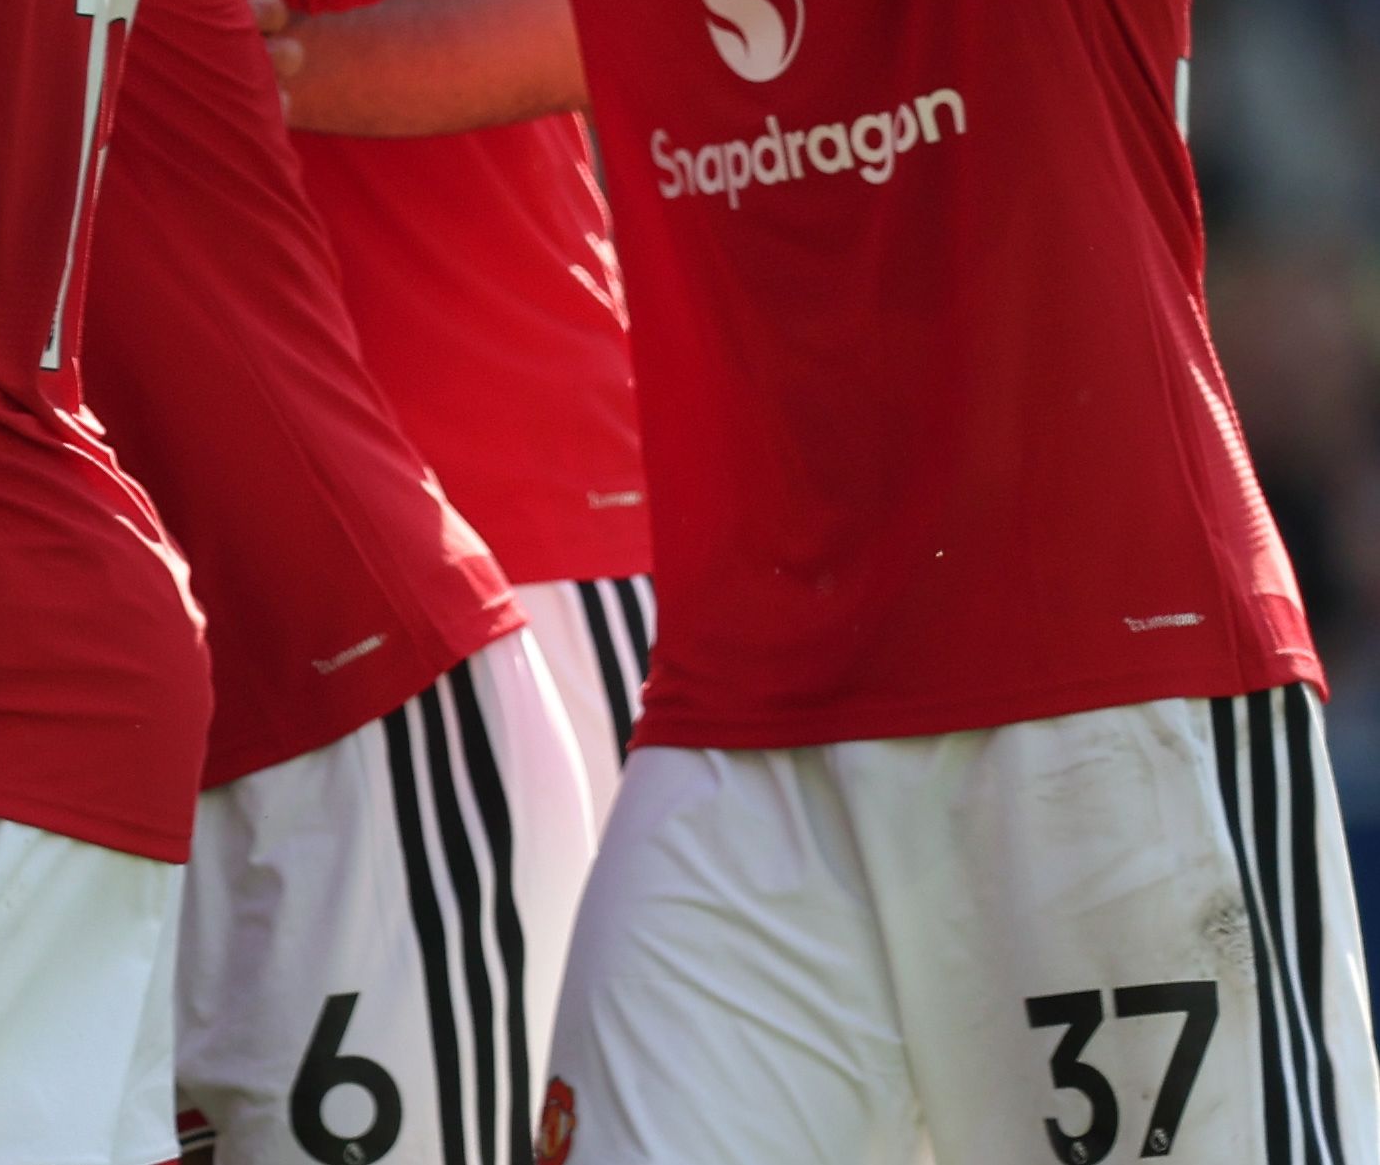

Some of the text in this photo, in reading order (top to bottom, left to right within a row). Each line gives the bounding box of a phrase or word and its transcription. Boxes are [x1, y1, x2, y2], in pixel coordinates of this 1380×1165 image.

[650, 88, 967, 210] Snapdragon
[291, 992, 402, 1165] 6
[1025, 980, 1219, 1165] 37
